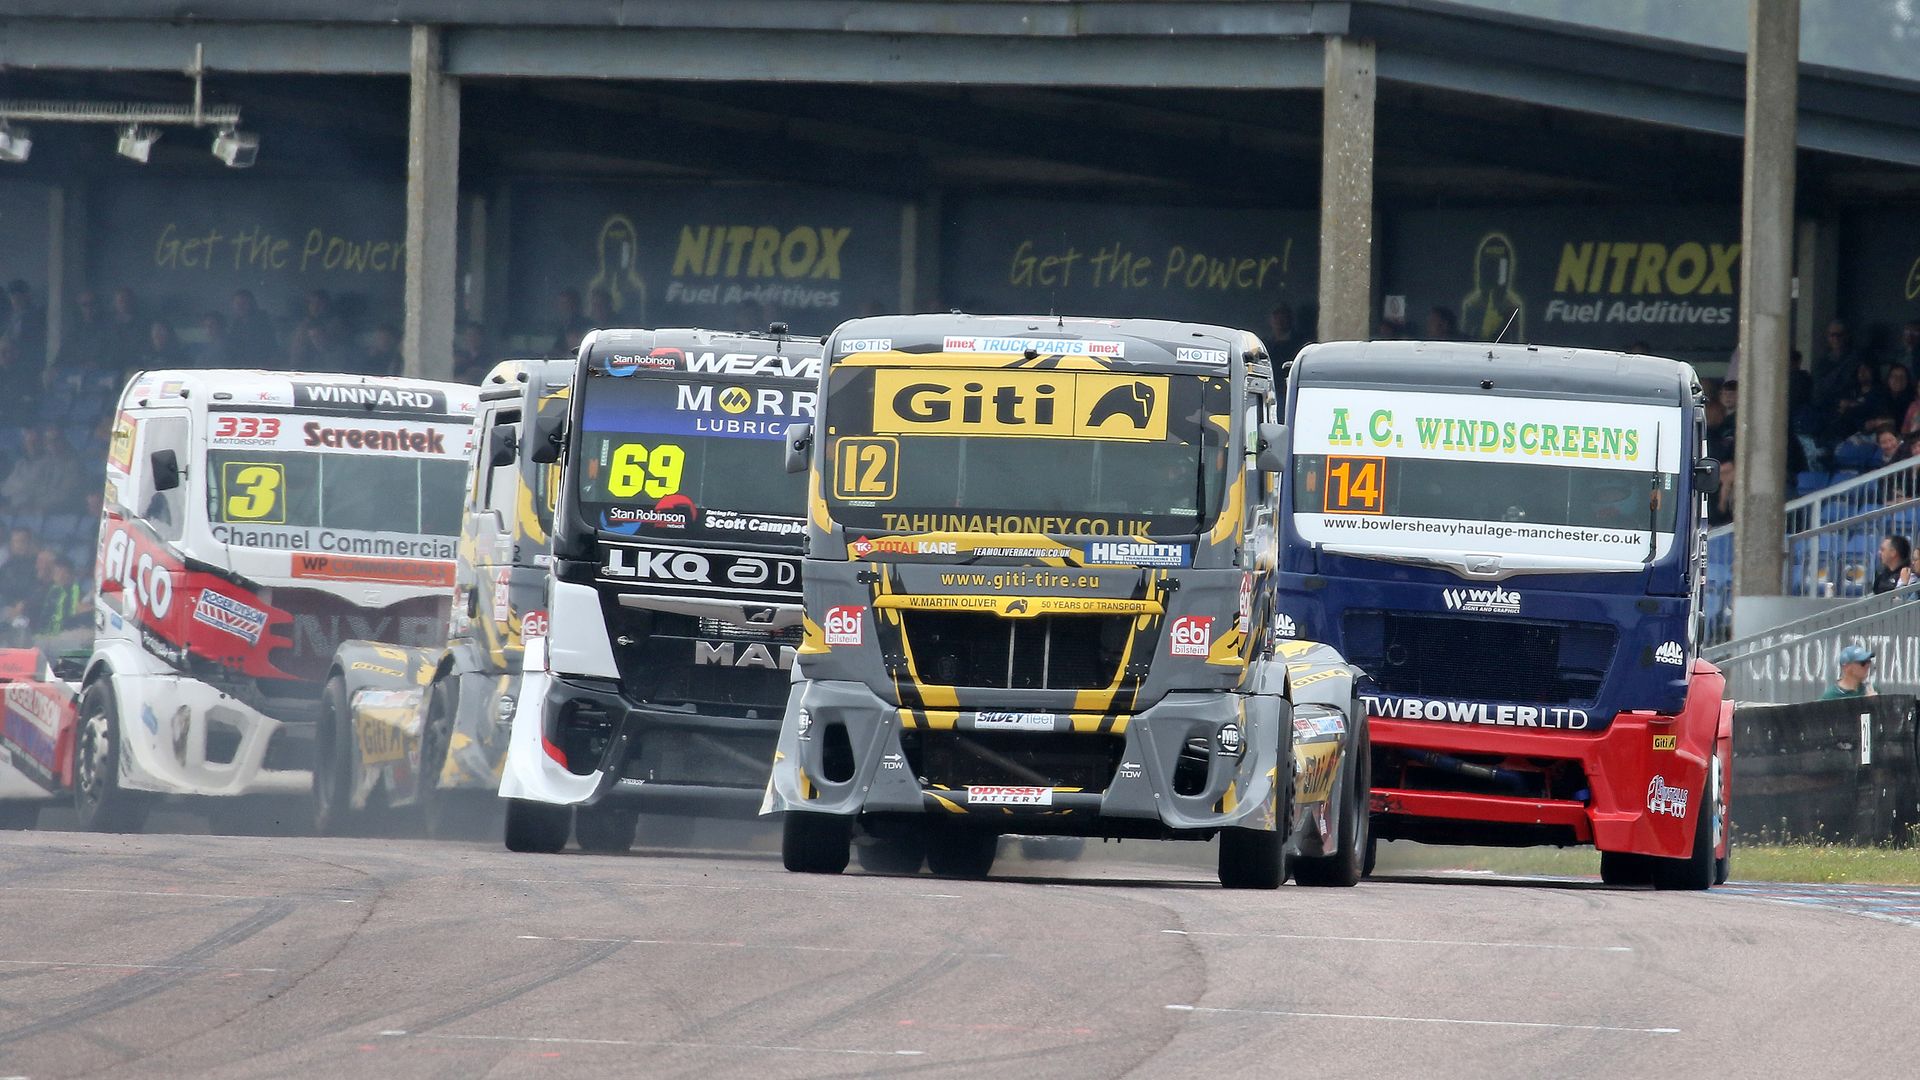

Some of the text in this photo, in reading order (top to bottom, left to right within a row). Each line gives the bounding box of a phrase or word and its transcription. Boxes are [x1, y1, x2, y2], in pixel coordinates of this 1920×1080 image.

[156, 224, 223, 269] Get
[232, 226, 288, 270] the
[672, 224, 851, 280] NITROX
[1010, 238, 1293, 290] Get the Power!
[1553, 242, 1741, 294] NITROX
[665, 282, 840, 308] Fuel Additives
[1545, 300, 1732, 325] Fuel Additives
[842, 341, 890, 352] MOTIS
[946, 338, 1119, 354] imex TRUCK PARTS imex
[1179, 350, 1227, 361] MOTIS
[613, 354, 675, 366] Stan Robinson
[306, 386, 434, 409] WINNARD
[892, 382, 1057, 426] Giti
[216, 416, 281, 438] 333
[304, 421, 446, 455] Screentek
[213, 437, 277, 447] MOTORSPORT
[1416, 417, 1640, 461] WINDSCREENS
[608, 443, 685, 499] 69
[844, 445, 887, 493] 12
[228, 466, 280, 518] 3
[1331, 463, 1378, 508] 14
[610, 507, 686, 522] Stan Robinson
[705, 516, 746, 529] Scott
[882, 514, 1151, 536] TAHUNAHONEY.COUK
[211, 525, 457, 560] Channel Commercial
[1324, 517, 1641, 546] www.bowlersheavyhaulage-manchester.co.uk
[876, 541, 957, 554] TOTALKARE
[973, 547, 1070, 557] TEAMOLIVERRACING.CO.UK
[303, 557, 447, 578] WP COMMERCIALS
[608, 549, 712, 583] LKQ
[941, 571, 1100, 589] www.giti-tire.eu
[961, 598, 997, 607] OLIVER
[1041, 601, 1051, 609] 50
[1052, 601, 1082, 609] YEARS
[1097, 602, 1146, 611] TRANSPORT
[1469, 585, 1521, 607] wyke
[824, 607, 862, 638] febi
[1170, 617, 1210, 647] febi
[829, 635, 857, 643] bilstein
[1175, 645, 1205, 654] bilstein
[1656, 640, 1684, 658] MAC
[1655, 656, 1683, 665] TOOLS
[1654, 737, 1668, 748] Giti
[970, 786, 1047, 796] ODYSSEY
